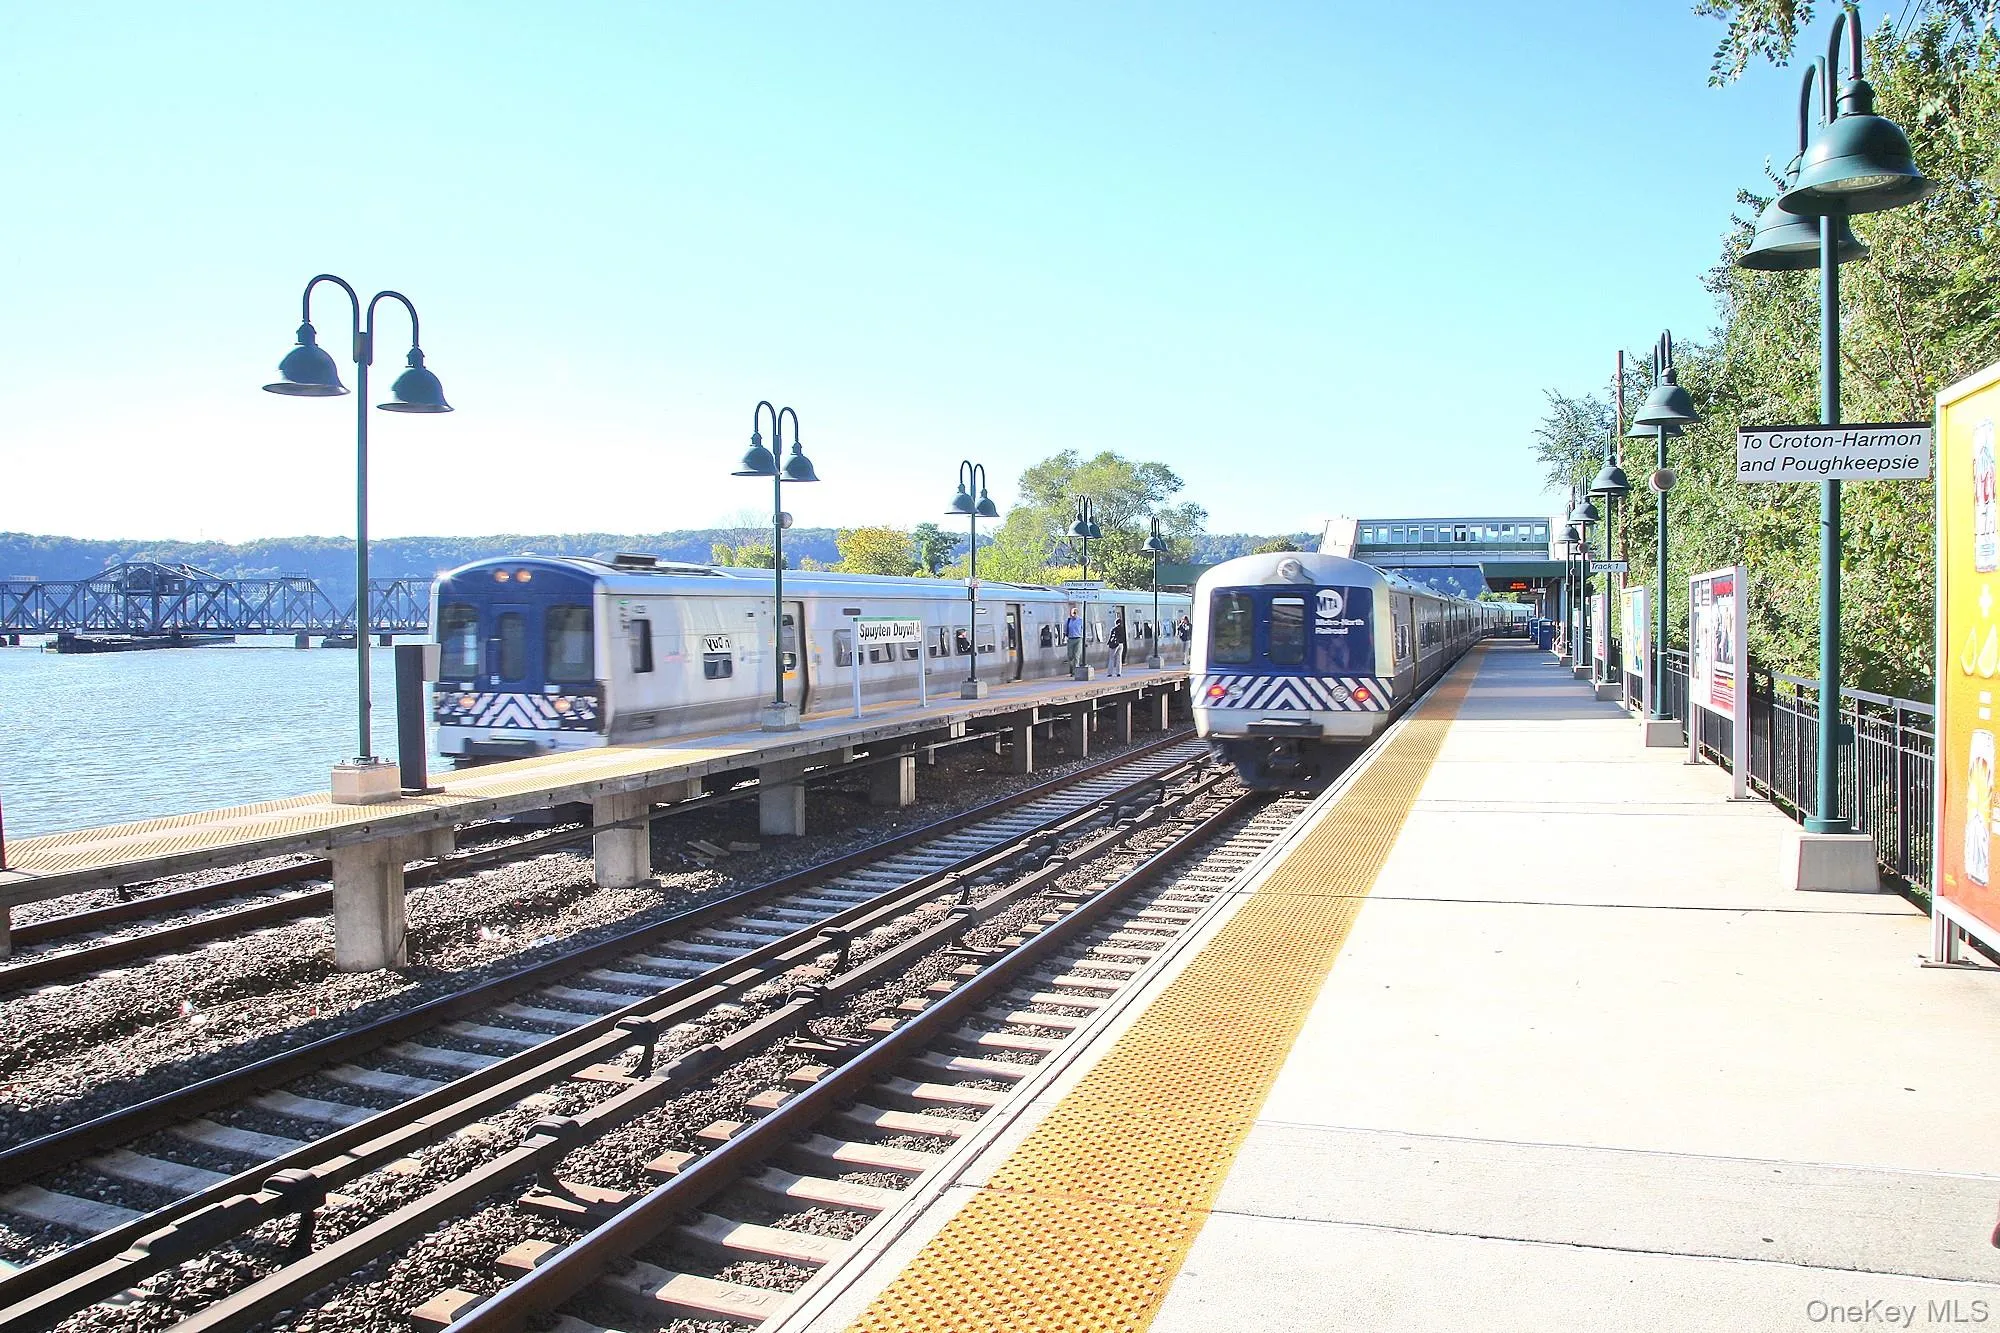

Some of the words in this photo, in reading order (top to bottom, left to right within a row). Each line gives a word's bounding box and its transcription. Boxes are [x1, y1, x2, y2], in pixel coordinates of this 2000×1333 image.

[1742, 434, 1762, 449] To
[1768, 432, 1921, 449] Croton-Harmon
[1740, 457, 1775, 472] and
[1781, 454, 1919, 474] Poughkeepsie
[1315, 593, 1339, 612] MTA
[1315, 618, 1365, 626] Metro-North
[860, 622, 891, 640] Spuyten
[893, 622, 915, 640] Duyvil
[1314, 627, 1349, 635] Railroad
